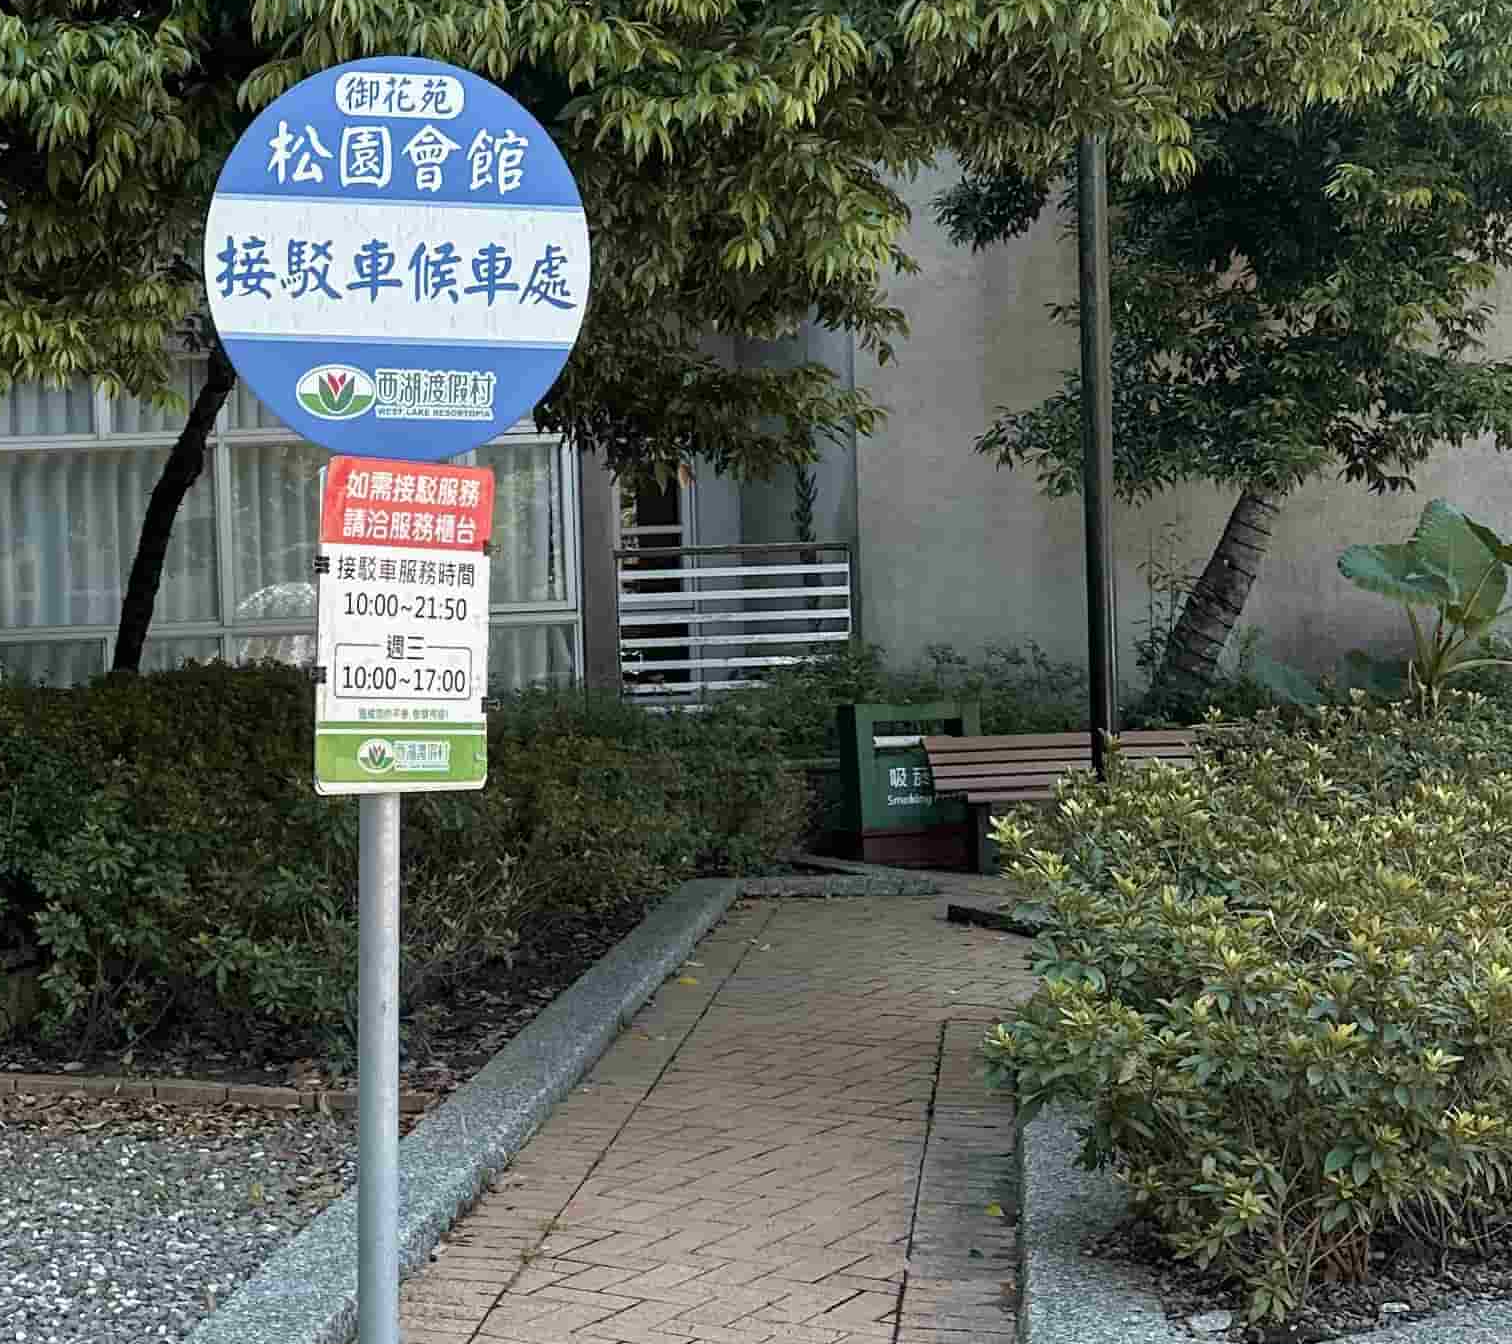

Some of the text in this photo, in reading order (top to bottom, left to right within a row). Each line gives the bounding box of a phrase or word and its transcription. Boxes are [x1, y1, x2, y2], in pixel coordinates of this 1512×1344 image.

[345, 78, 453, 115] 御花苑
[267, 119, 529, 195] 松園會館
[215, 235, 578, 310] 接駁車候車處
[376, 370, 494, 407] 西湖渡假村
[406, 408, 430, 416] LAKE
[346, 469, 481, 508] 如需接駁服務
[343, 507, 476, 544] 請洽服務櫃台
[337, 555, 475, 587] 接駁車服務時間
[344, 592, 468, 621] 10:00~21:50
[387, 634, 425, 660] 週三
[342, 665, 466, 693] 10:00~17:00
